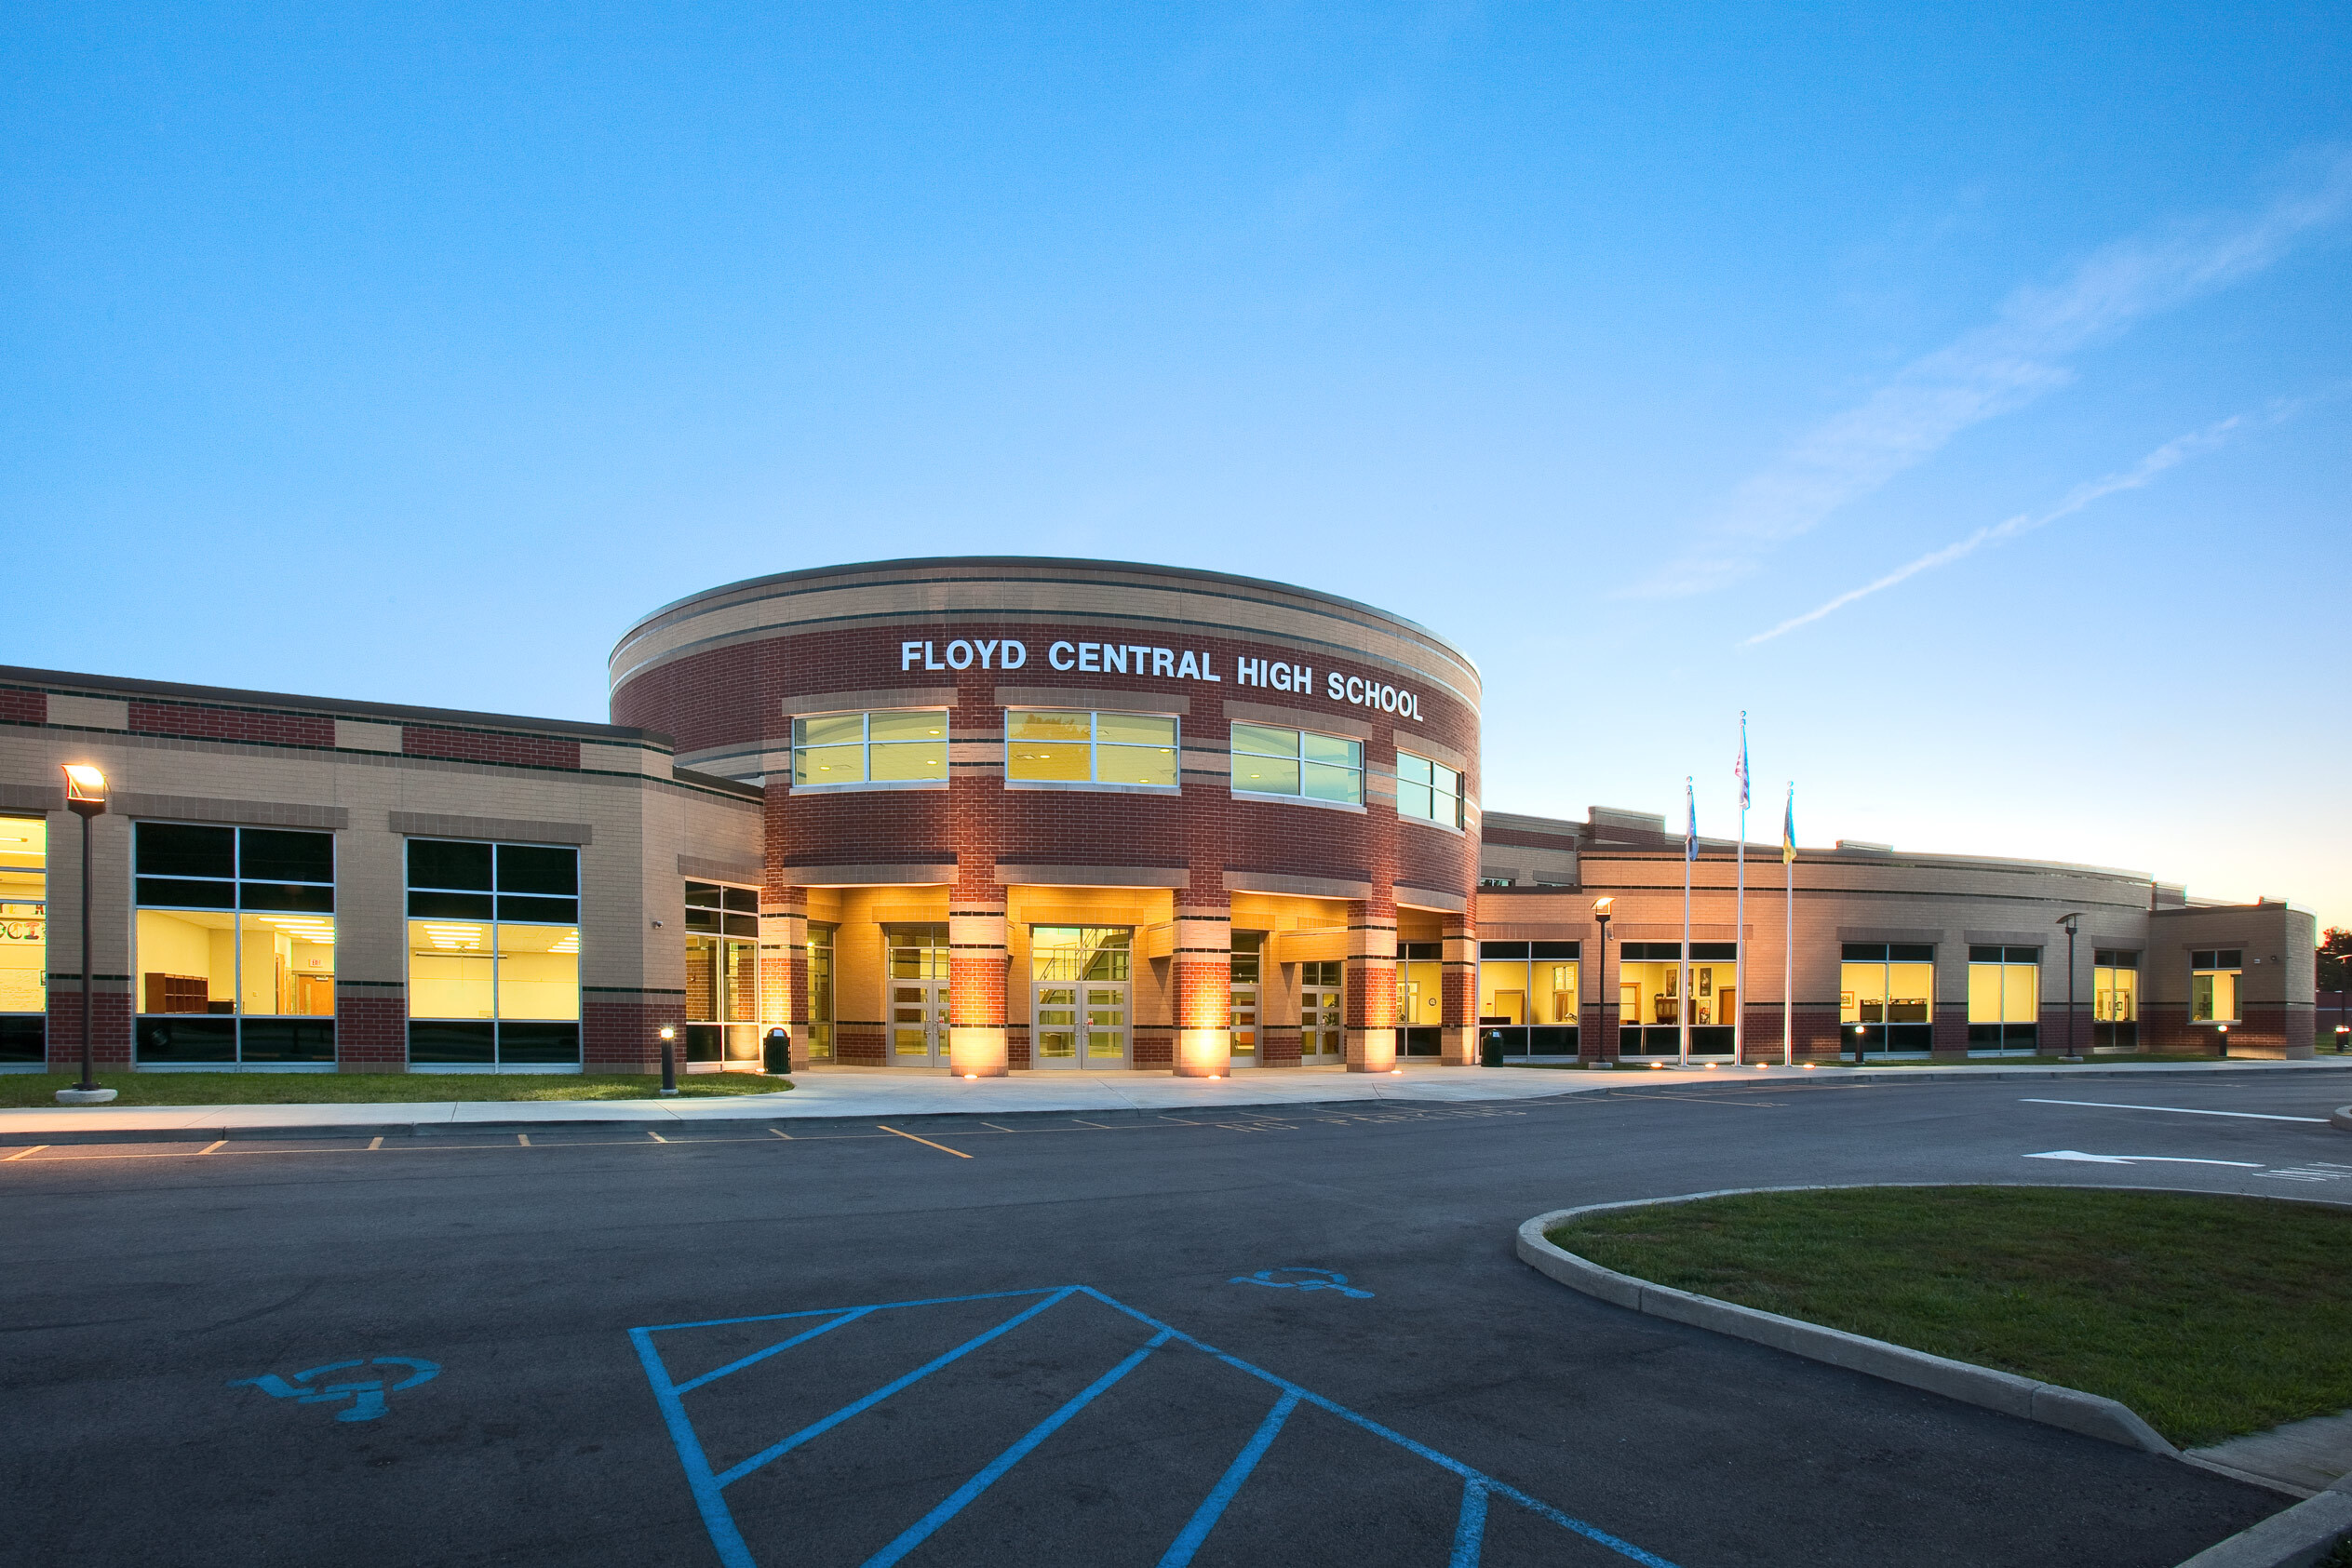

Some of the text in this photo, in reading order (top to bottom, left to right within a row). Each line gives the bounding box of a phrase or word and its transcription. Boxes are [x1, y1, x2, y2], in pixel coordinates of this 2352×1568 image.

[902, 639, 1423, 722] FLOYD CENTRAL HIGH SCHOOL
[1216, 1122, 1300, 1132] NO
